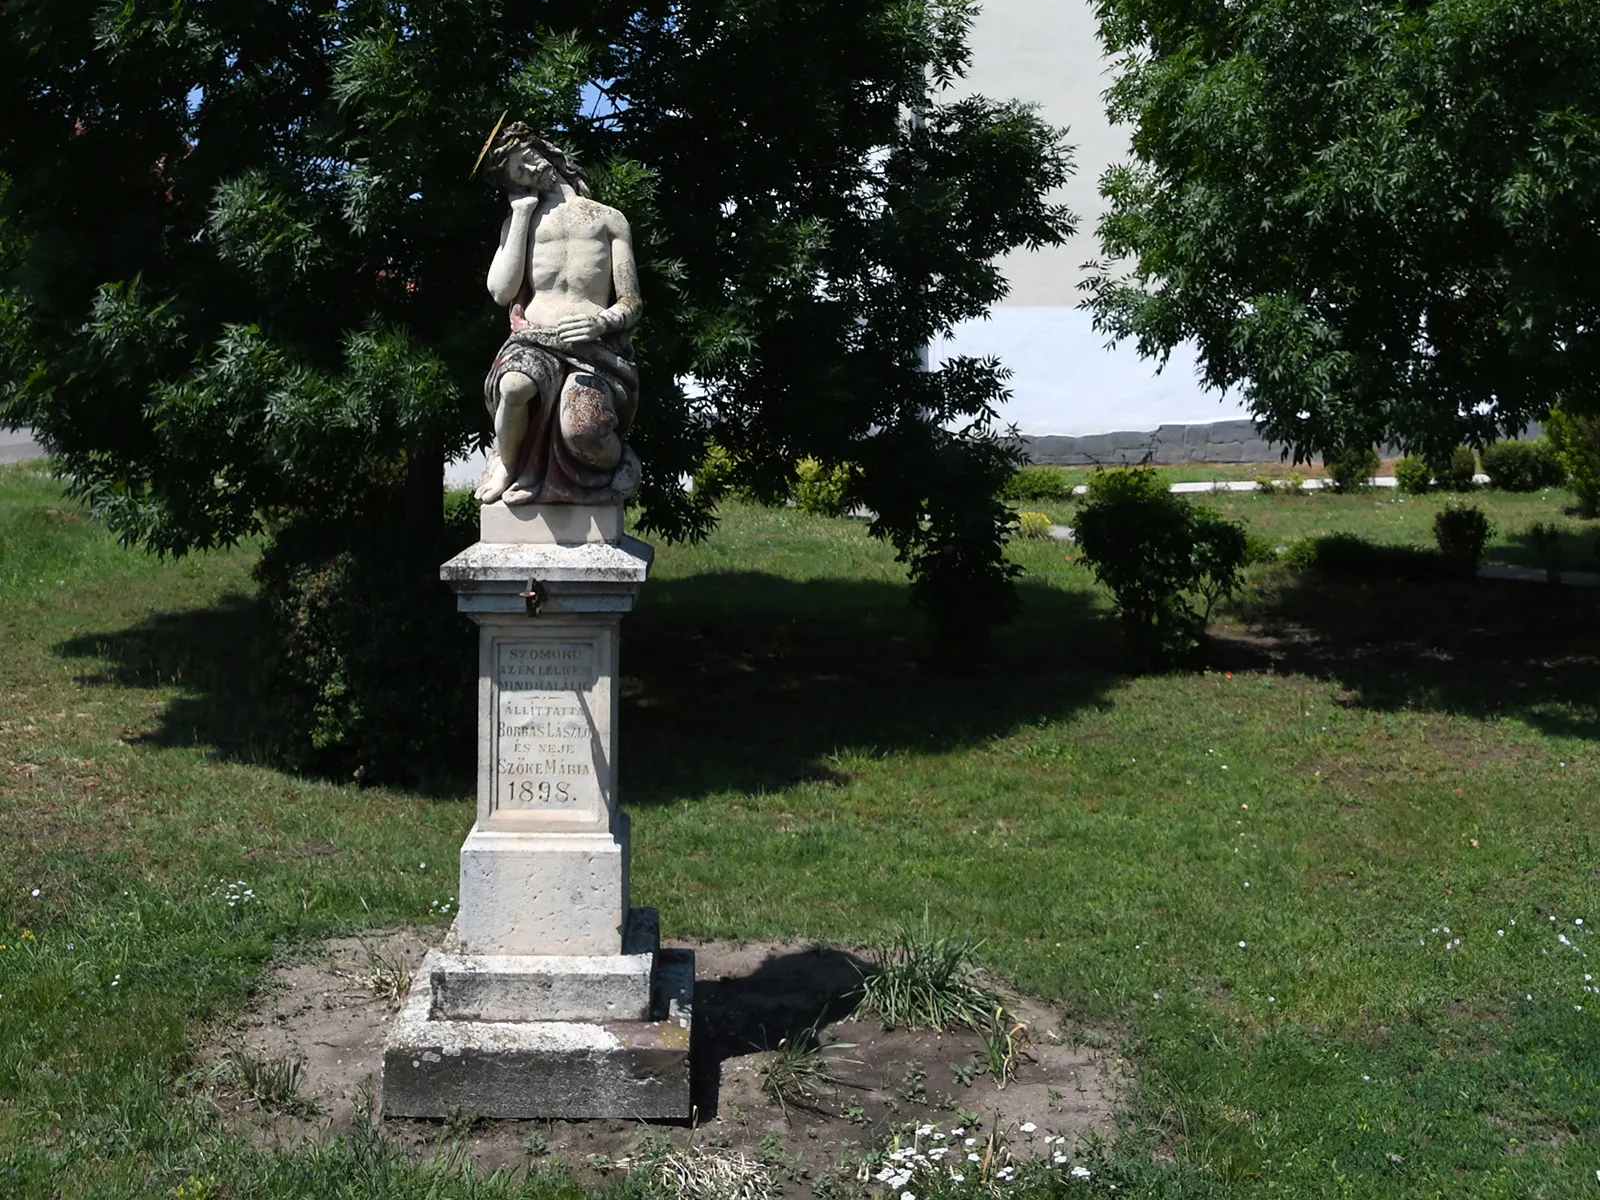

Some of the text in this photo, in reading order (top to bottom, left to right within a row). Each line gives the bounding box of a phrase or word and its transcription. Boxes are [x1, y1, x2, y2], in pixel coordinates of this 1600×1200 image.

[499, 665, 515, 675] AZ
[518, 661, 535, 675] ÉN
[505, 701, 584, 716] ÁLLÍTTATTA
[514, 740, 531, 752] ÉS
[508, 781, 577, 802] 1898.
